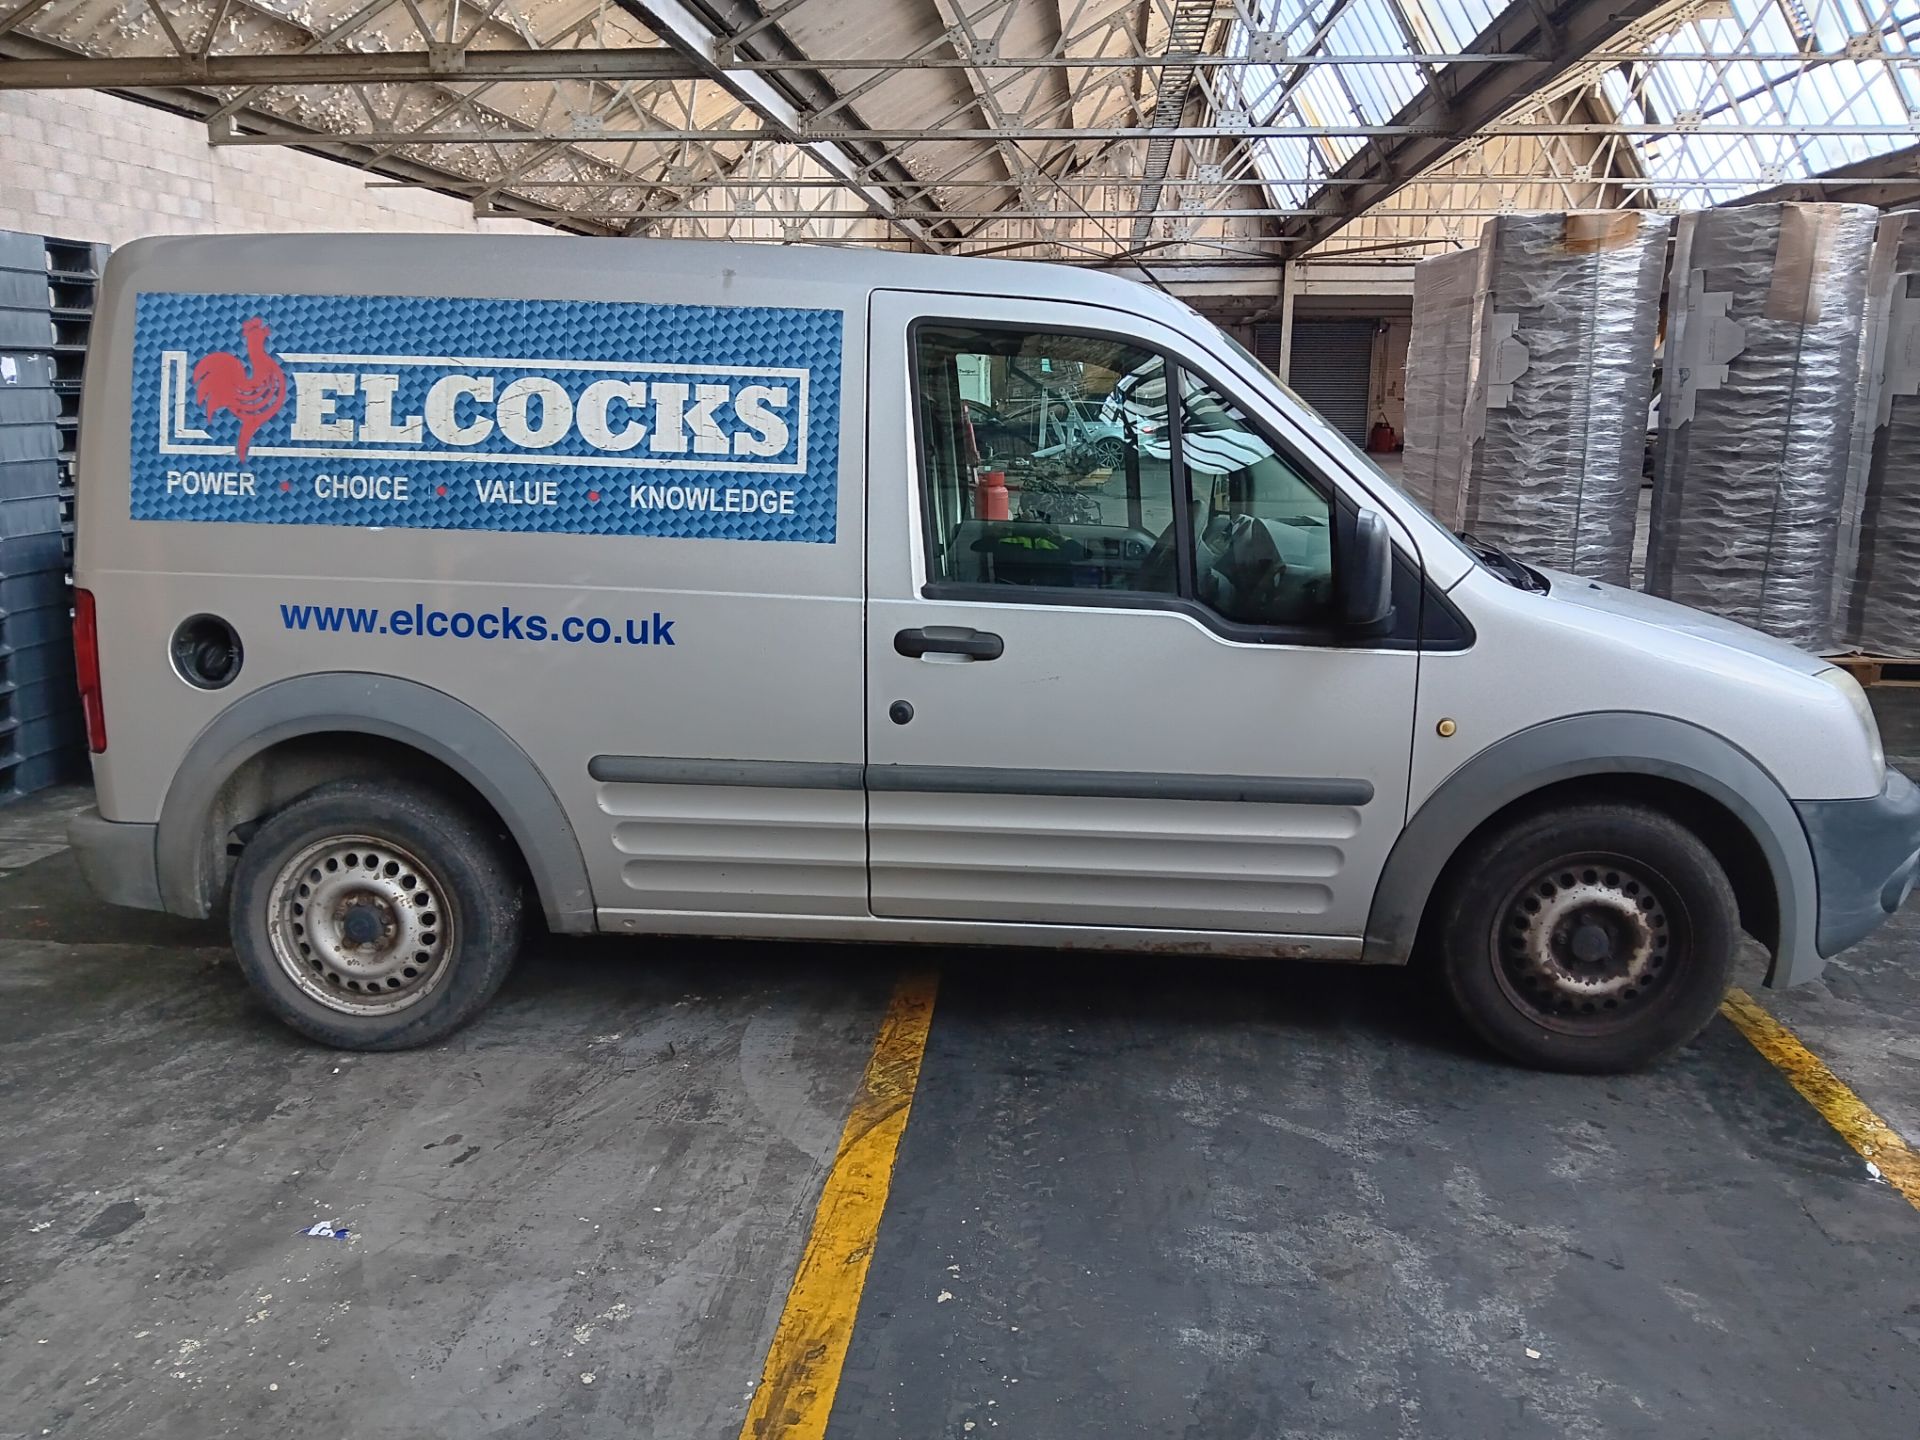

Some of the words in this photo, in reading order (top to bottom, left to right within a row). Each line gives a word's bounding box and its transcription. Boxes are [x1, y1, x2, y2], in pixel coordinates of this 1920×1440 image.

[290, 371, 790, 457] ELCOCKS
[166, 470, 256, 496] POWER
[314, 474, 409, 501] CHOICE
[475, 479, 558, 506] VALUE
[630, 484, 795, 515] KNOWLEDGE
[279, 603, 676, 646] www.elcocks.co.uk
